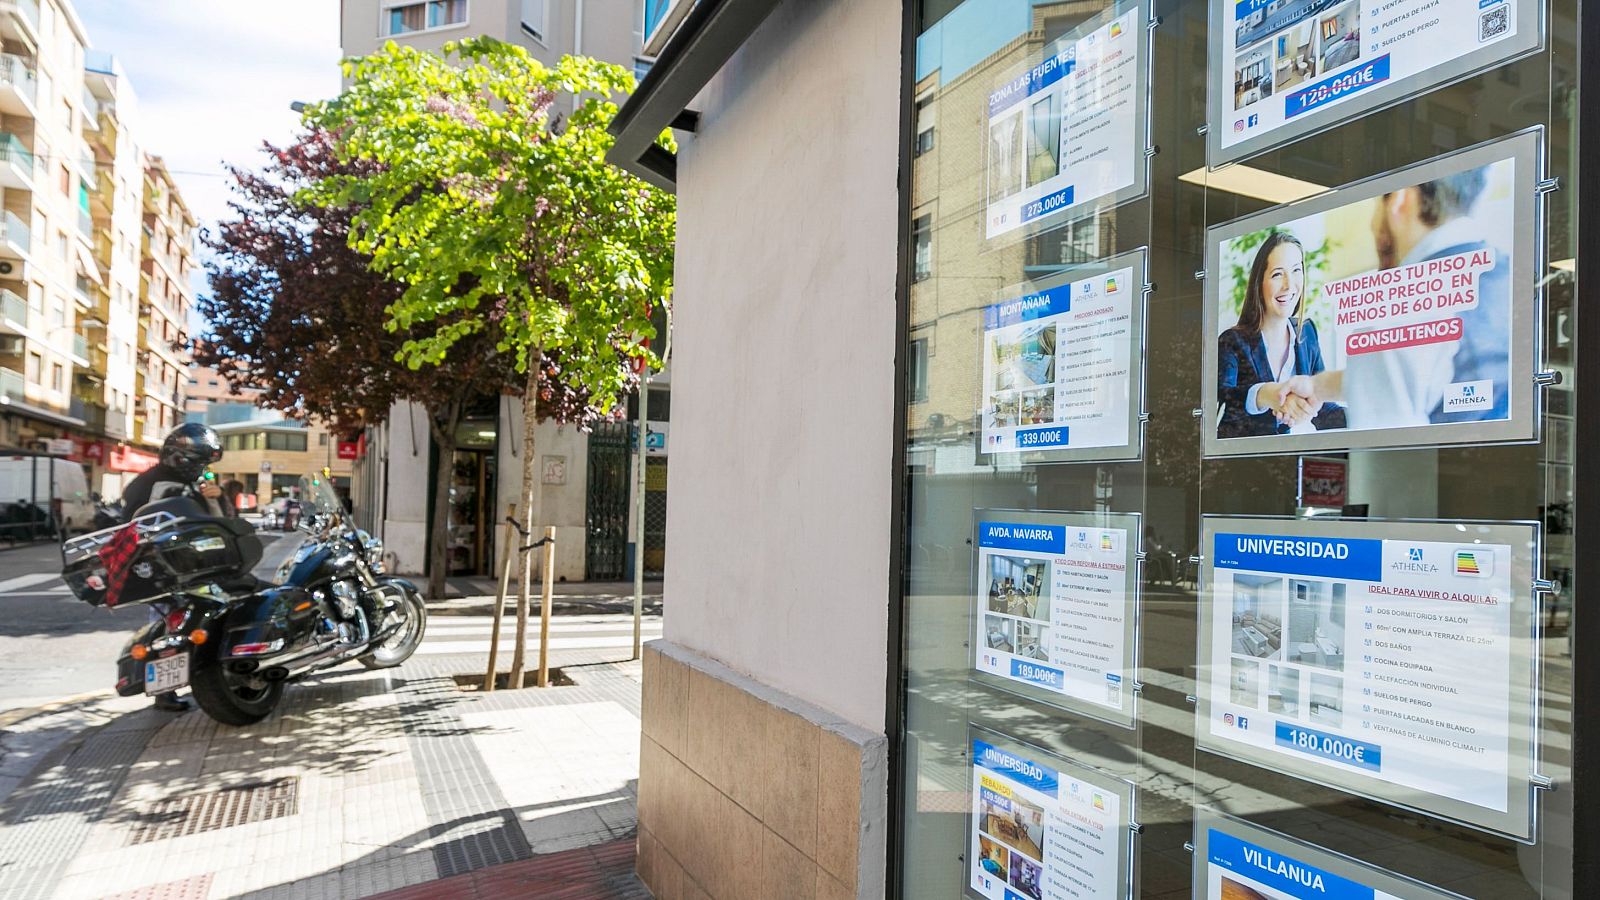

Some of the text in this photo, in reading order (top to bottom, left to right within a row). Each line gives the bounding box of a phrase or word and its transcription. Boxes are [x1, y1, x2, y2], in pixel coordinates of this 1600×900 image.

[1382, 0, 1440, 28] PUERTAS DE HAYA
[1382, 18, 1440, 46] SUELOS DE PERGO
[990, 86, 1014, 106] ZONA
[1014, 72, 1032, 92] LAS
[1032, 47, 1076, 81] FUENTES
[1300, 65, 1374, 107] 120.000€
[1028, 192, 1066, 217] 273.000€
[1326, 251, 1491, 297] VENDEMOS TU PISO AL
[1338, 272, 1472, 310] MEJOR PRECIO EN
[1000, 294, 1050, 317] MONTAÑANA
[1337, 290, 1474, 326] MENOS DE 60 DIAS
[1349, 320, 1460, 350] CONSULTENOS
[1448, 396, 1486, 406] ATHENEA
[1023, 431, 1060, 444] 339.000€
[988, 527, 1054, 541] AVDA. NAVARRA
[1237, 538, 1348, 559] UNIVERSIDAD
[1392, 562, 1439, 573] ATHENEA
[1368, 585, 1391, 594] IDEAL
[1394, 588, 1415, 596] PARA
[1418, 590, 1440, 599] VIVIR
[1452, 593, 1498, 605] ALQUILAR
[1392, 610, 1437, 620] DORMITORIOS
[1444, 614, 1468, 624] SALÓN
[1408, 629, 1432, 638] AMPLIA
[1434, 632, 1464, 641] TERRAZA
[1390, 641, 1412, 652] BAÑOS
[156, 656, 186, 673] 5306
[1018, 663, 1056, 684] 189.000€
[1374, 658, 1433, 672] COCINA EQUIPADA
[157, 671, 180, 684] FTH
[1420, 682, 1458, 694] INDIVIDUAL
[1374, 692, 1398, 701] SUELOS
[1409, 698, 1432, 708] PERGO
[1374, 707, 1402, 719] PUERTAS
[1403, 713, 1434, 726] LACADAS
[1446, 722, 1475, 734] BLANCO
[1289, 730, 1364, 763] 180.000€
[1373, 724, 1406, 737] VENTANAS
[1418, 733, 1451, 747] ALUMINIO
[1452, 741, 1485, 754] CLIMALIT
[985, 748, 1042, 781] UNIVERSIDAD
[1243, 846, 1325, 892] VILLANUA
